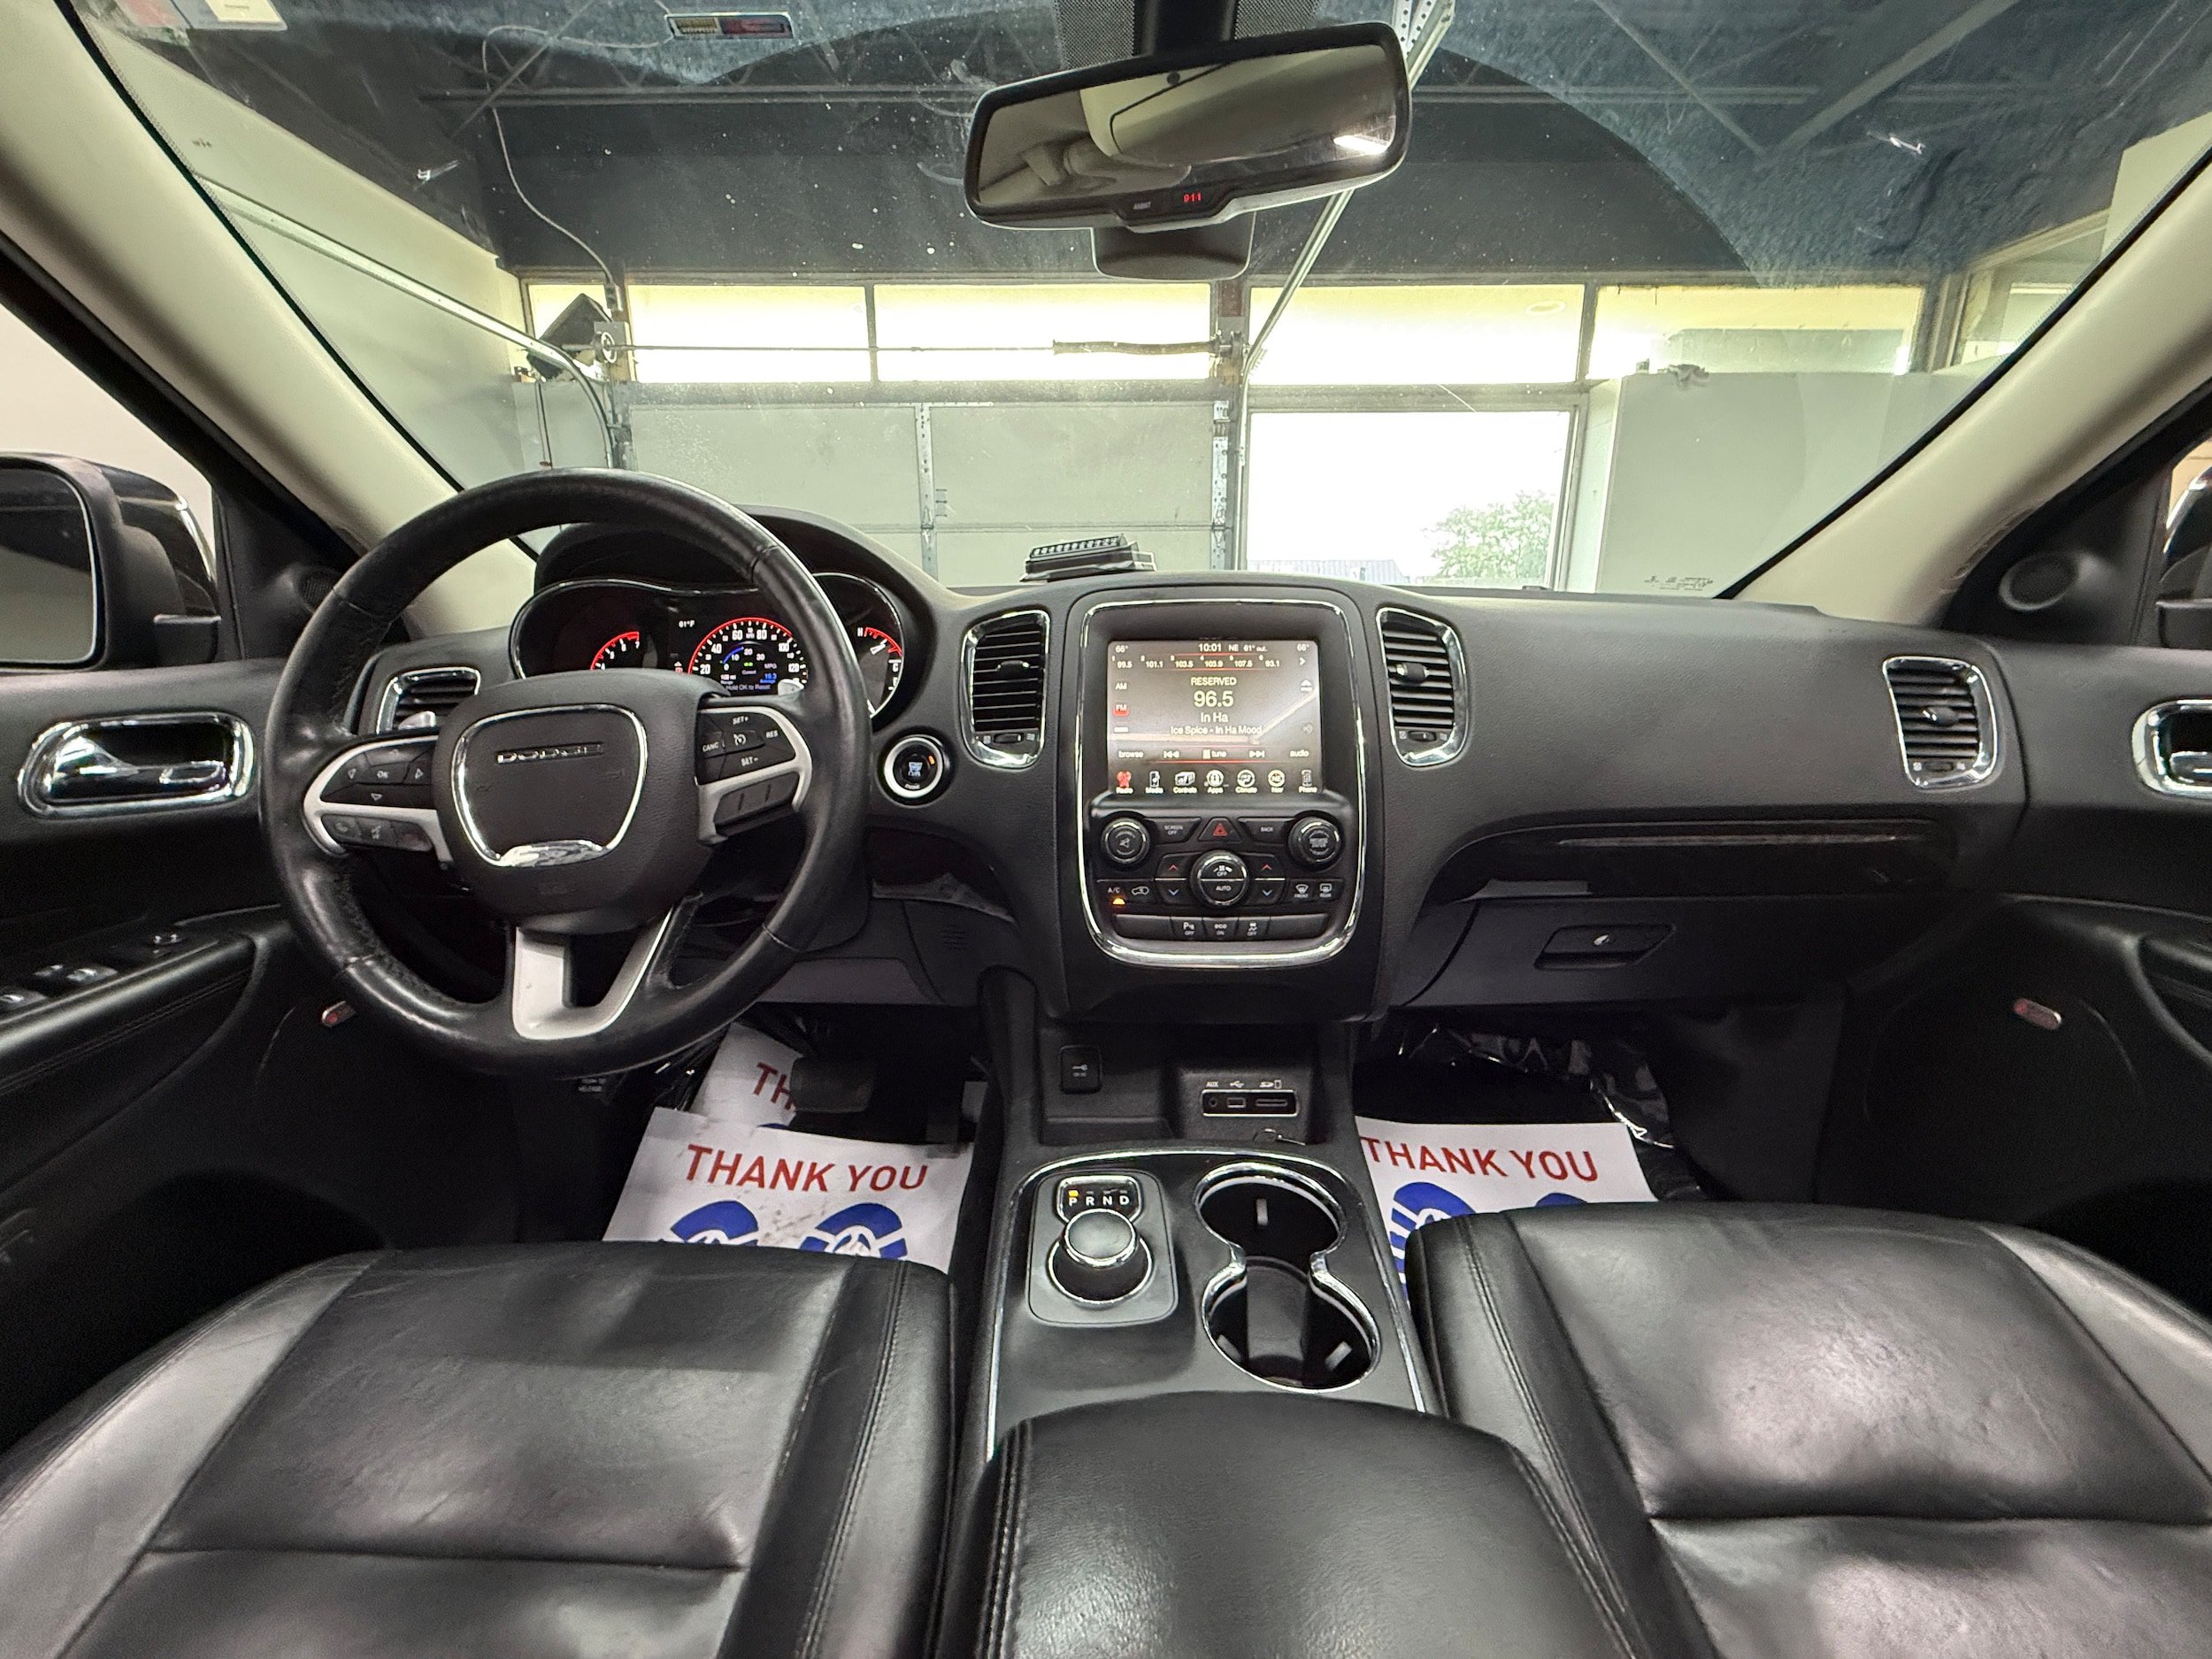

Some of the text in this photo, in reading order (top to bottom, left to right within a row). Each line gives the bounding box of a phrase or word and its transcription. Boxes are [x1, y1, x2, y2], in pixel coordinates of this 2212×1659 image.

[1183, 192, 1202, 203] 911
[732, 630, 742, 640] 60
[757, 629, 767, 640] 80
[857, 627, 864, 637] H
[711, 643, 722, 654] 40
[779, 642, 789, 652] 100
[1199, 643, 1221, 652] 10:01
[700, 664, 710, 674] 20
[788, 663, 800, 672] 120
[1191, 677, 1237, 686] RESERVED
[1194, 690, 1233, 708] 96.5
[1200, 712, 1229, 723] In Ha
[1185, 726, 1208, 736] Spice
[703, 741, 718, 752] CANC
[1360, 1136, 1598, 1182] THANK YOU
[687, 1144, 928, 1193] THANK YOU
[1069, 1195, 1129, 1207] P R N D
